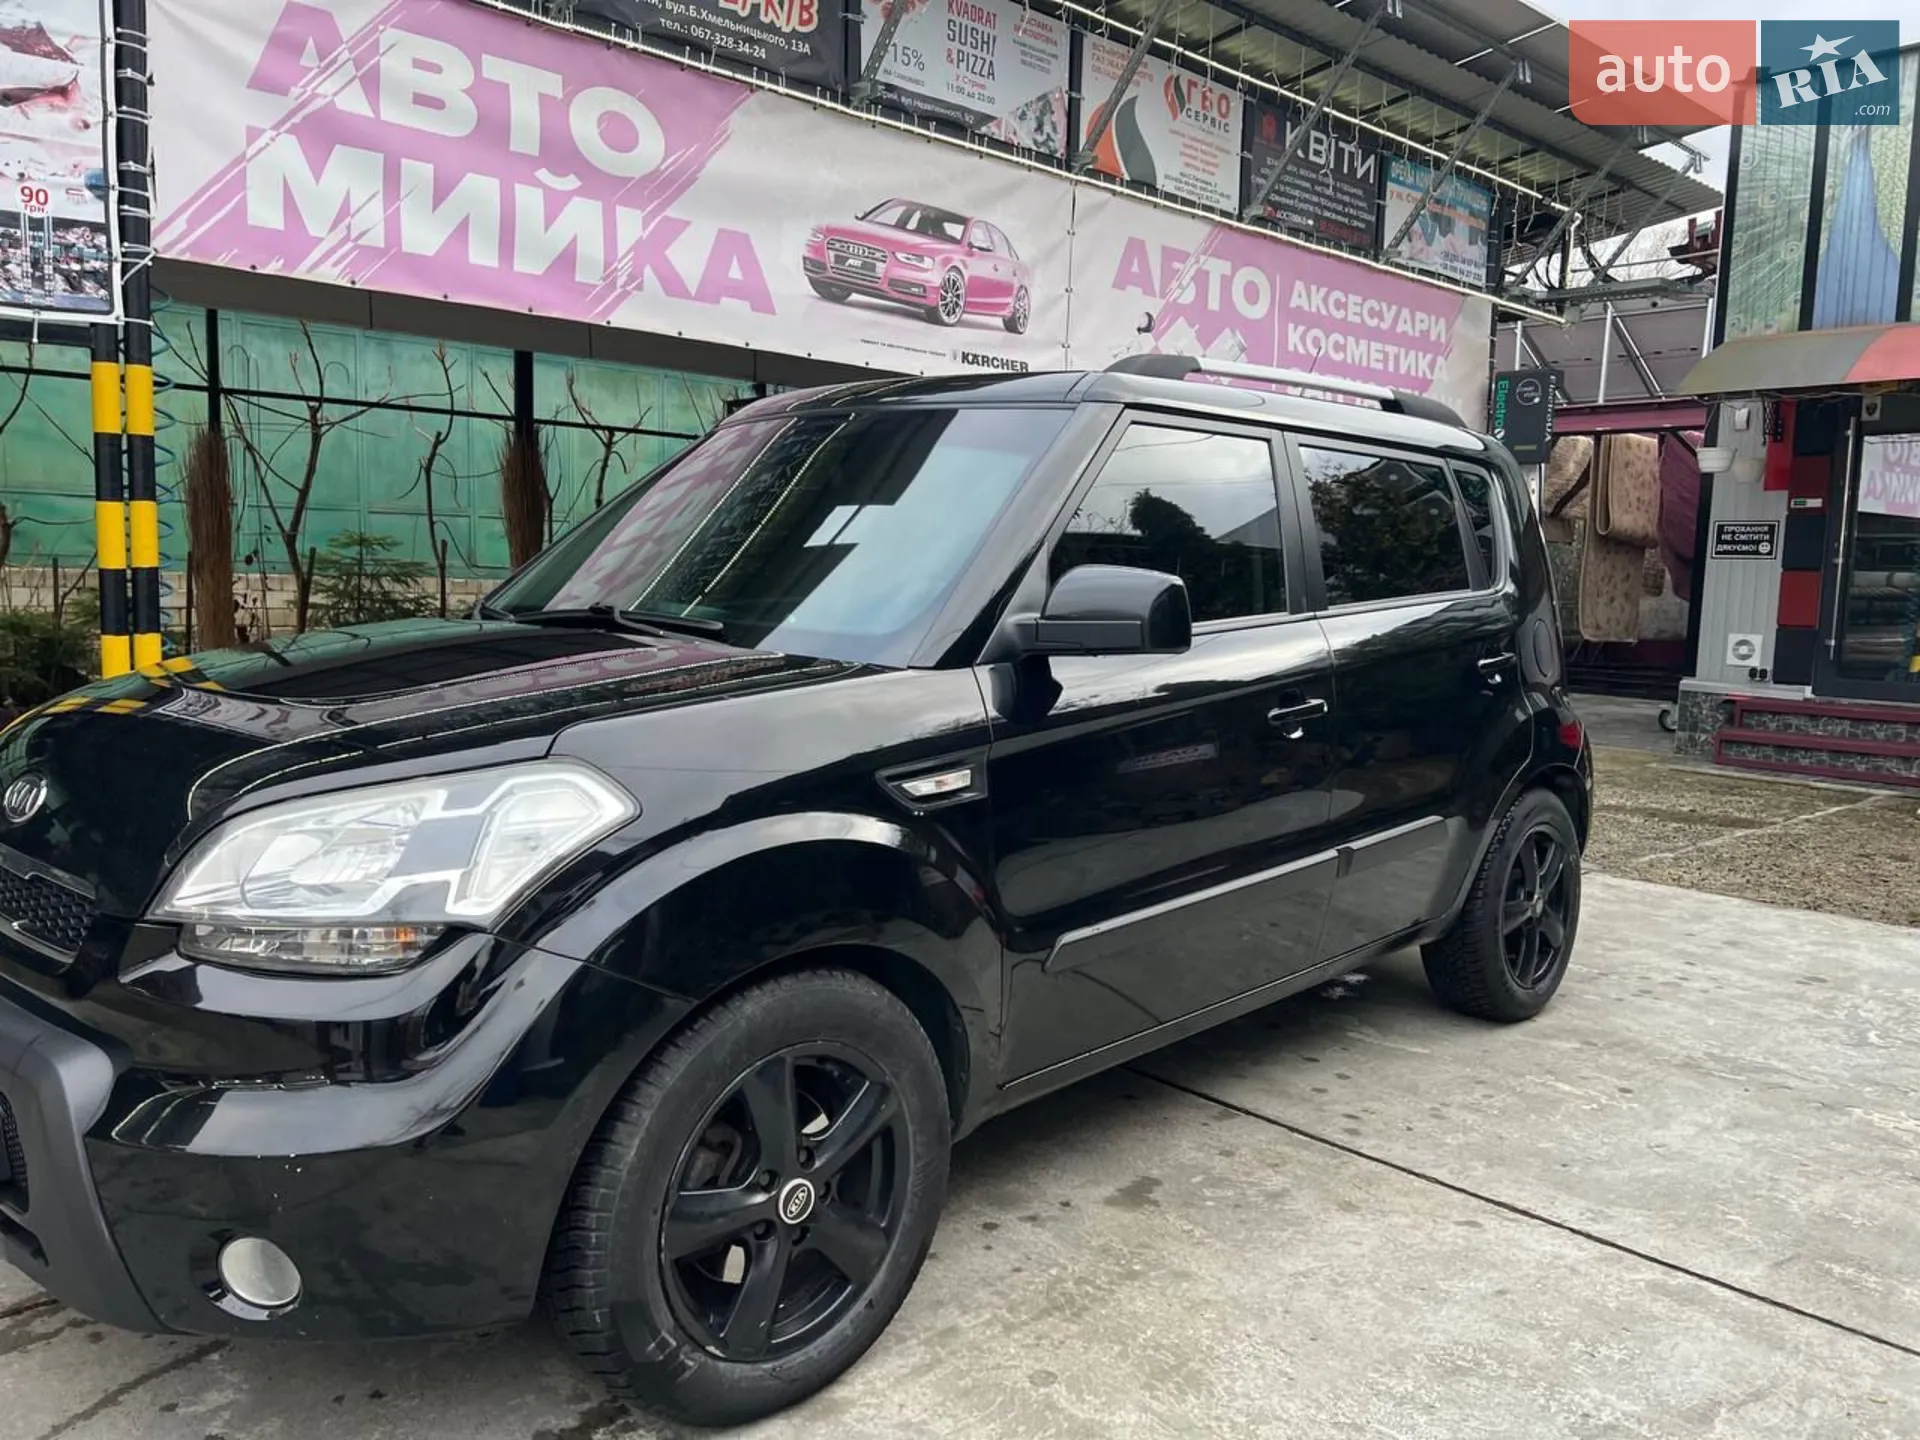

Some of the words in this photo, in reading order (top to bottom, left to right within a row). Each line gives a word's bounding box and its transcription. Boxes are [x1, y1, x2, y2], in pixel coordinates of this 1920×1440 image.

[659, 17, 688, 34] тел.:
[690, 24, 766, 59] 067-328-34-24
[947, 18, 998, 57] SUSHI
[956, 49, 996, 81] PIZZA
[245, 0, 666, 178] АВТО
[1185, 107, 1231, 133] СЕРВІС
[1285, 120, 1376, 185] КВІТИ
[20, 185, 49, 206] 90
[245, 125, 777, 316] МИЙКА
[1111, 235, 1272, 321] АВТО
[1288, 279, 1449, 344] АКСЕСУАРИ
[961, 350, 1029, 373] KÄRCHER
[1287, 322, 1451, 382] КОСМЕТИКА
[789, 1189, 806, 1214] KIA
